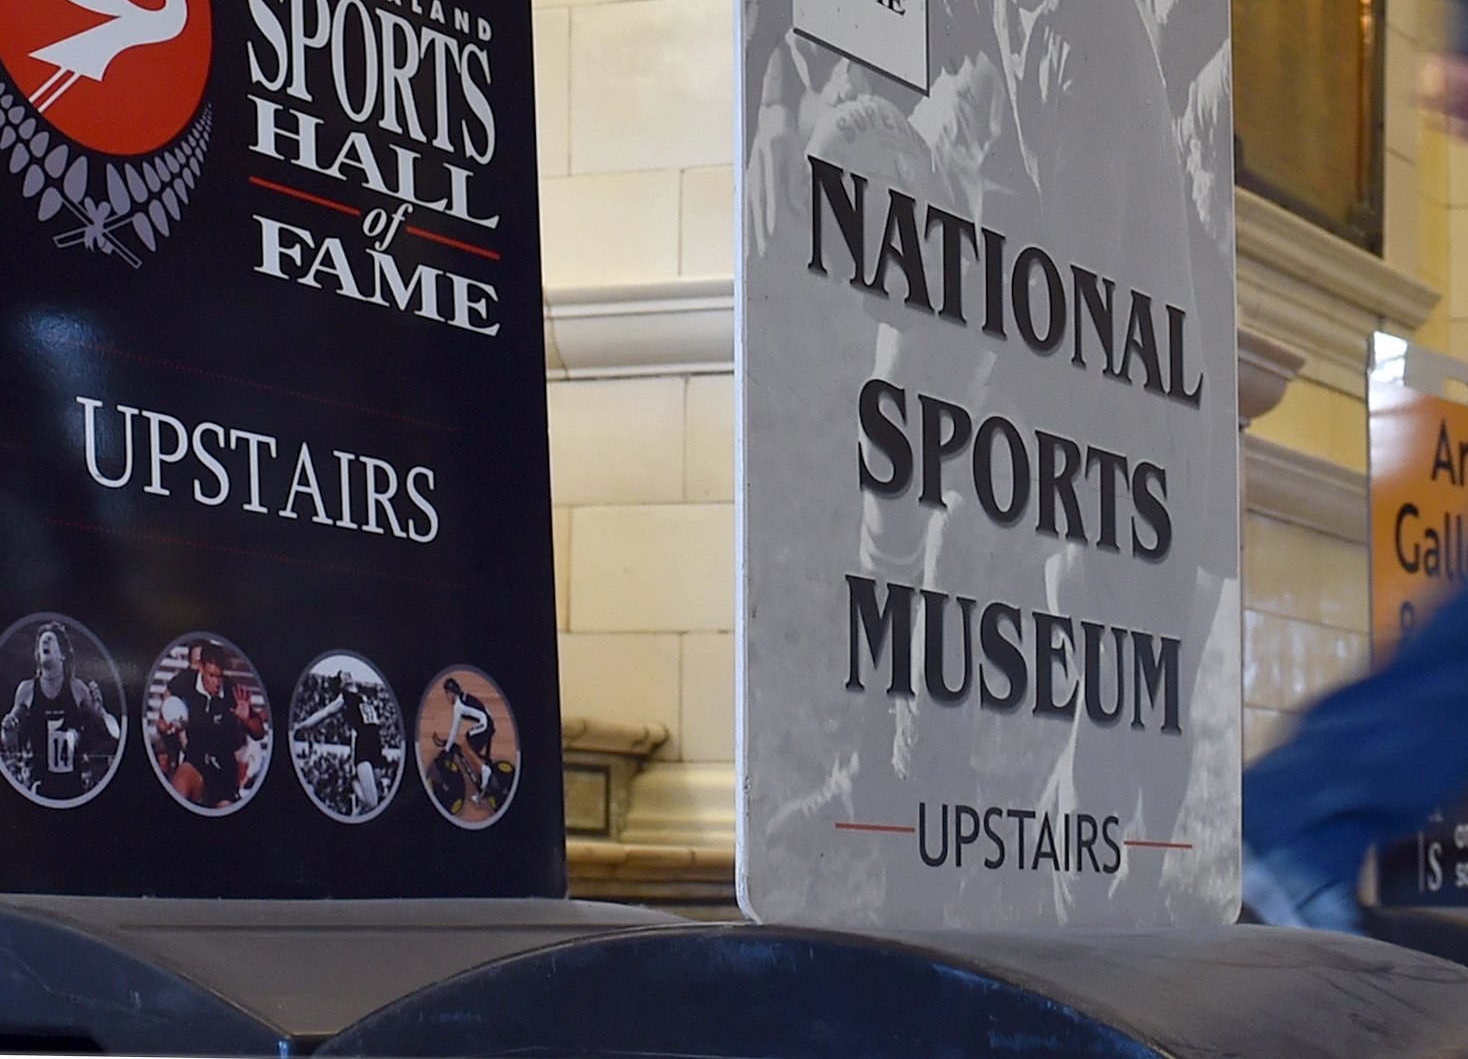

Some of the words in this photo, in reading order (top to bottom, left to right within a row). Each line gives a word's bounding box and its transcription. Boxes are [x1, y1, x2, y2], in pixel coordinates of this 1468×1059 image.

[247, 94, 501, 230] HALL
[362, 203, 414, 252] of
[252, 214, 501, 338] FAME
[807, 154, 1203, 409] NATIONAL
[76, 396, 440, 544] UPSTAIRS
[857, 379, 1173, 564] SPORTS
[845, 574, 1182, 736] MUSEUM
[918, 802, 1122, 874] UPSTAIRS
[1427, 842, 1443, 892] S
